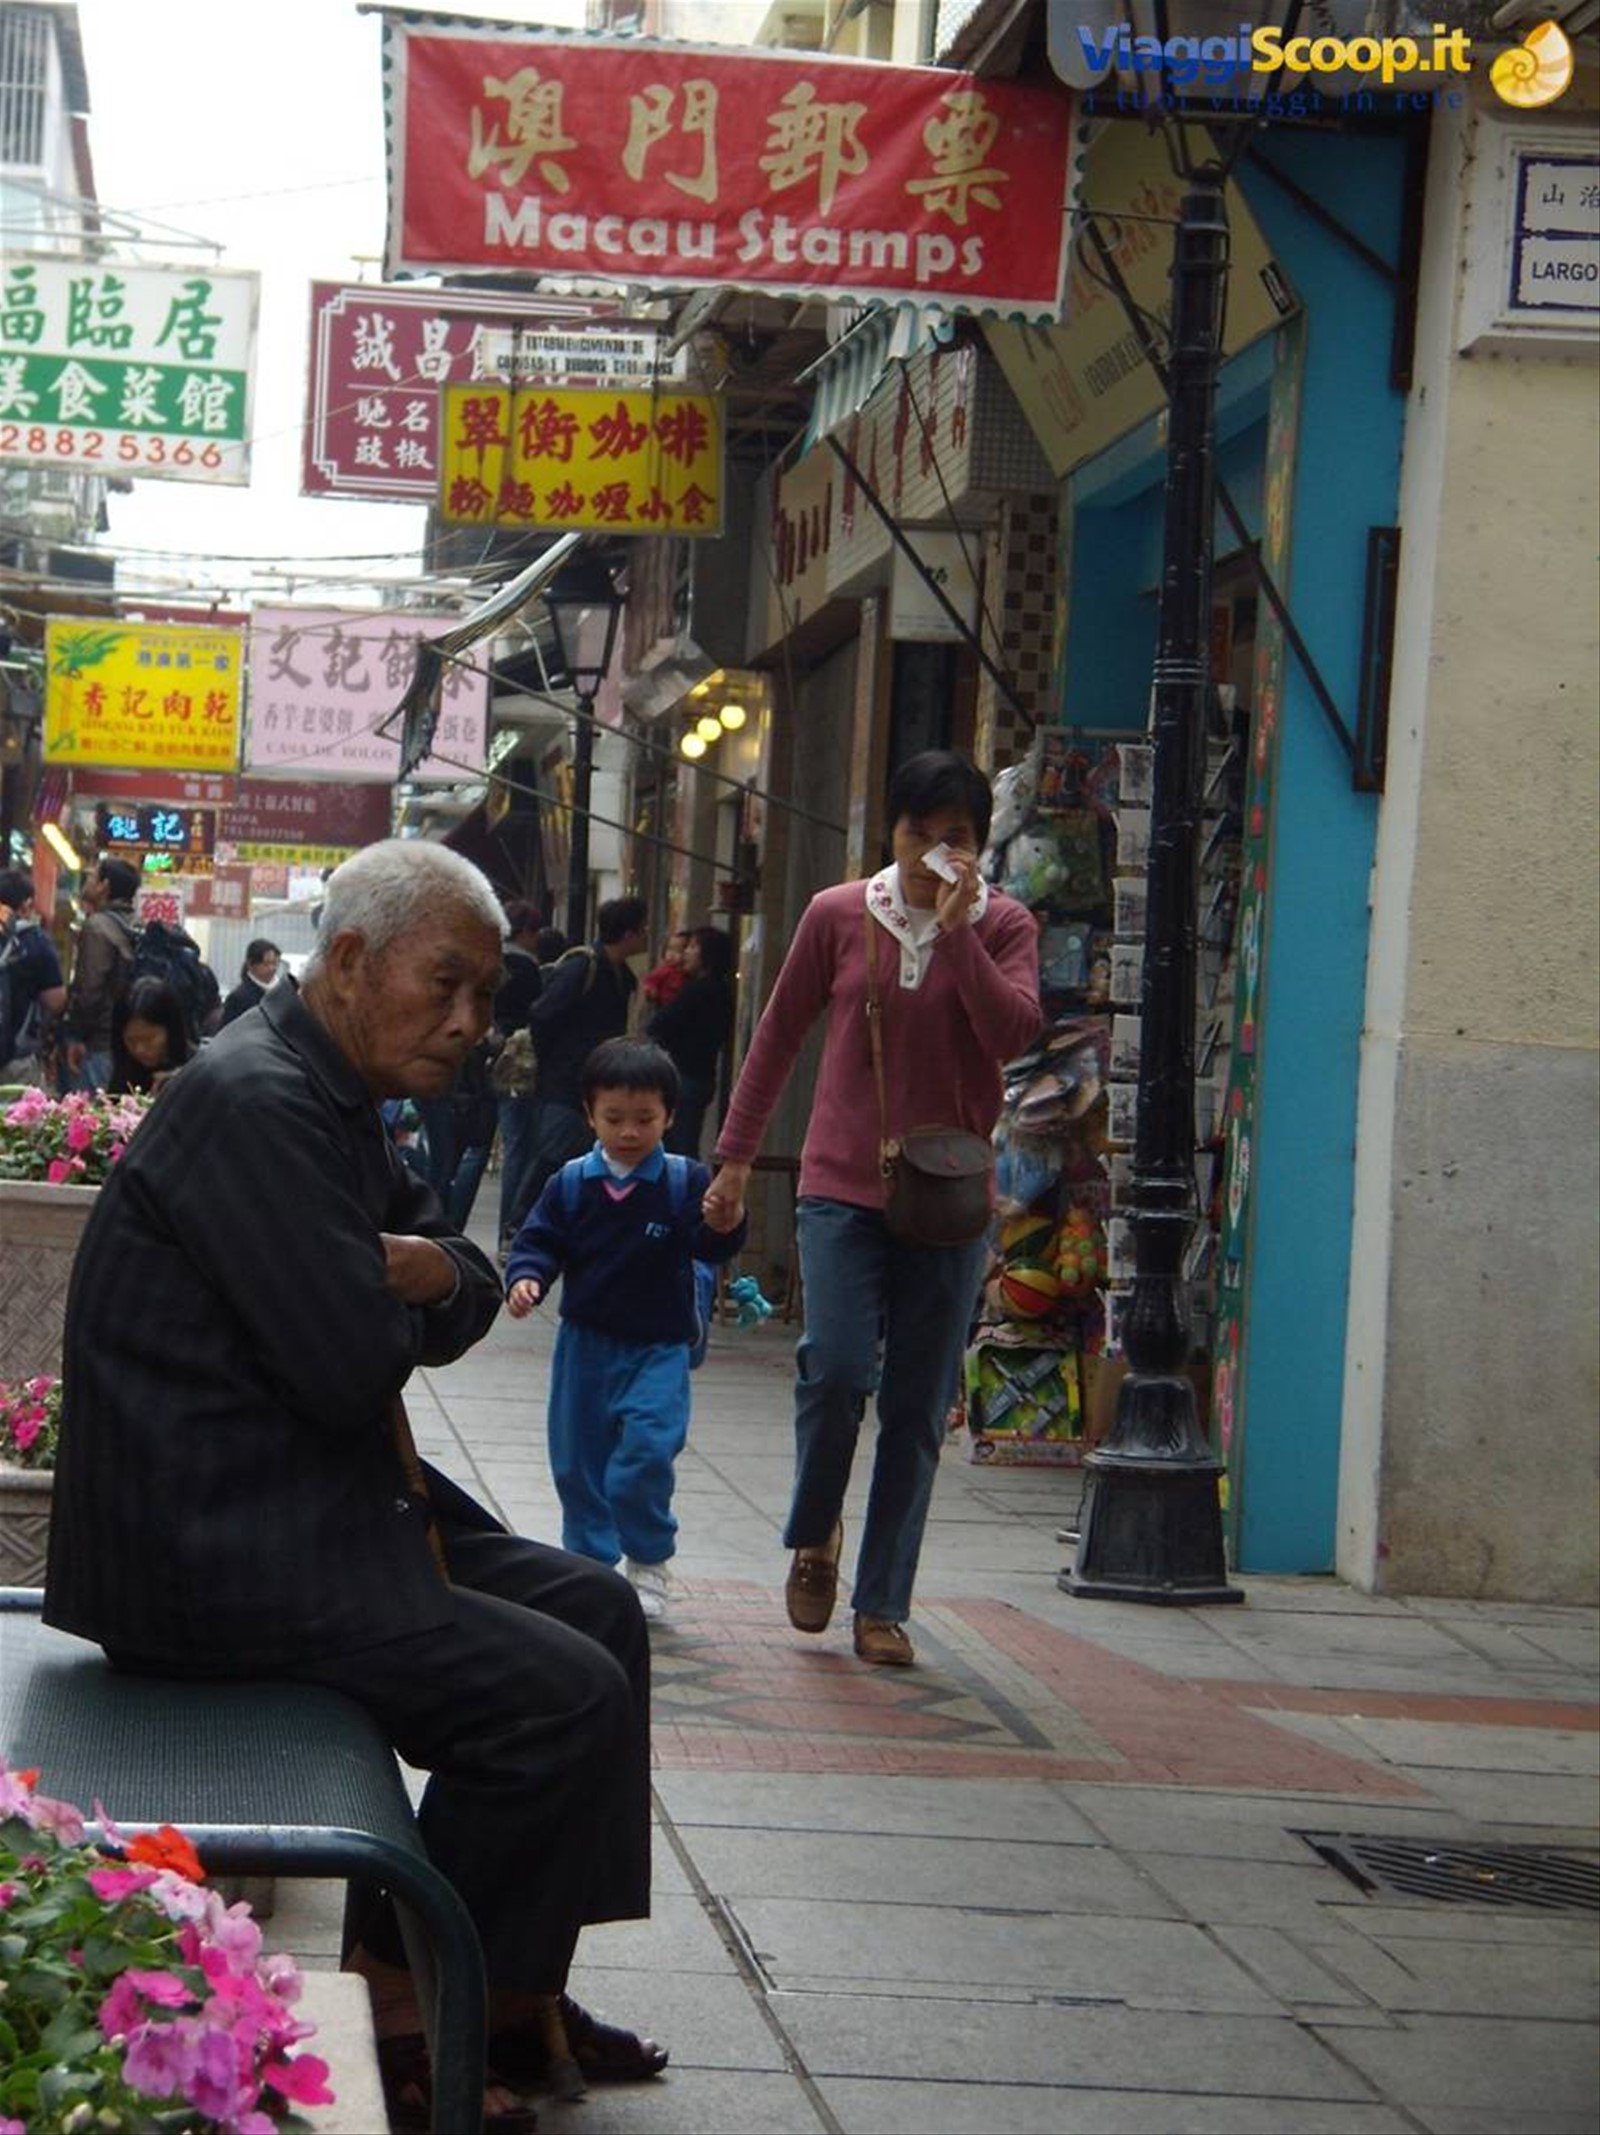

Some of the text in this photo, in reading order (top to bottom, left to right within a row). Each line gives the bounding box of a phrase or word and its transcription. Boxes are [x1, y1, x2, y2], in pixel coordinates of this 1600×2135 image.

[467, 66, 1009, 226] 澳門郵票
[484, 191, 716, 261] Macau
[738, 207, 984, 282] Stamps
[1531, 261, 1598, 282] LARGO
[0, 424, 223, 469] 2882 5366
[83, 682, 234, 724] 香記肉乾
